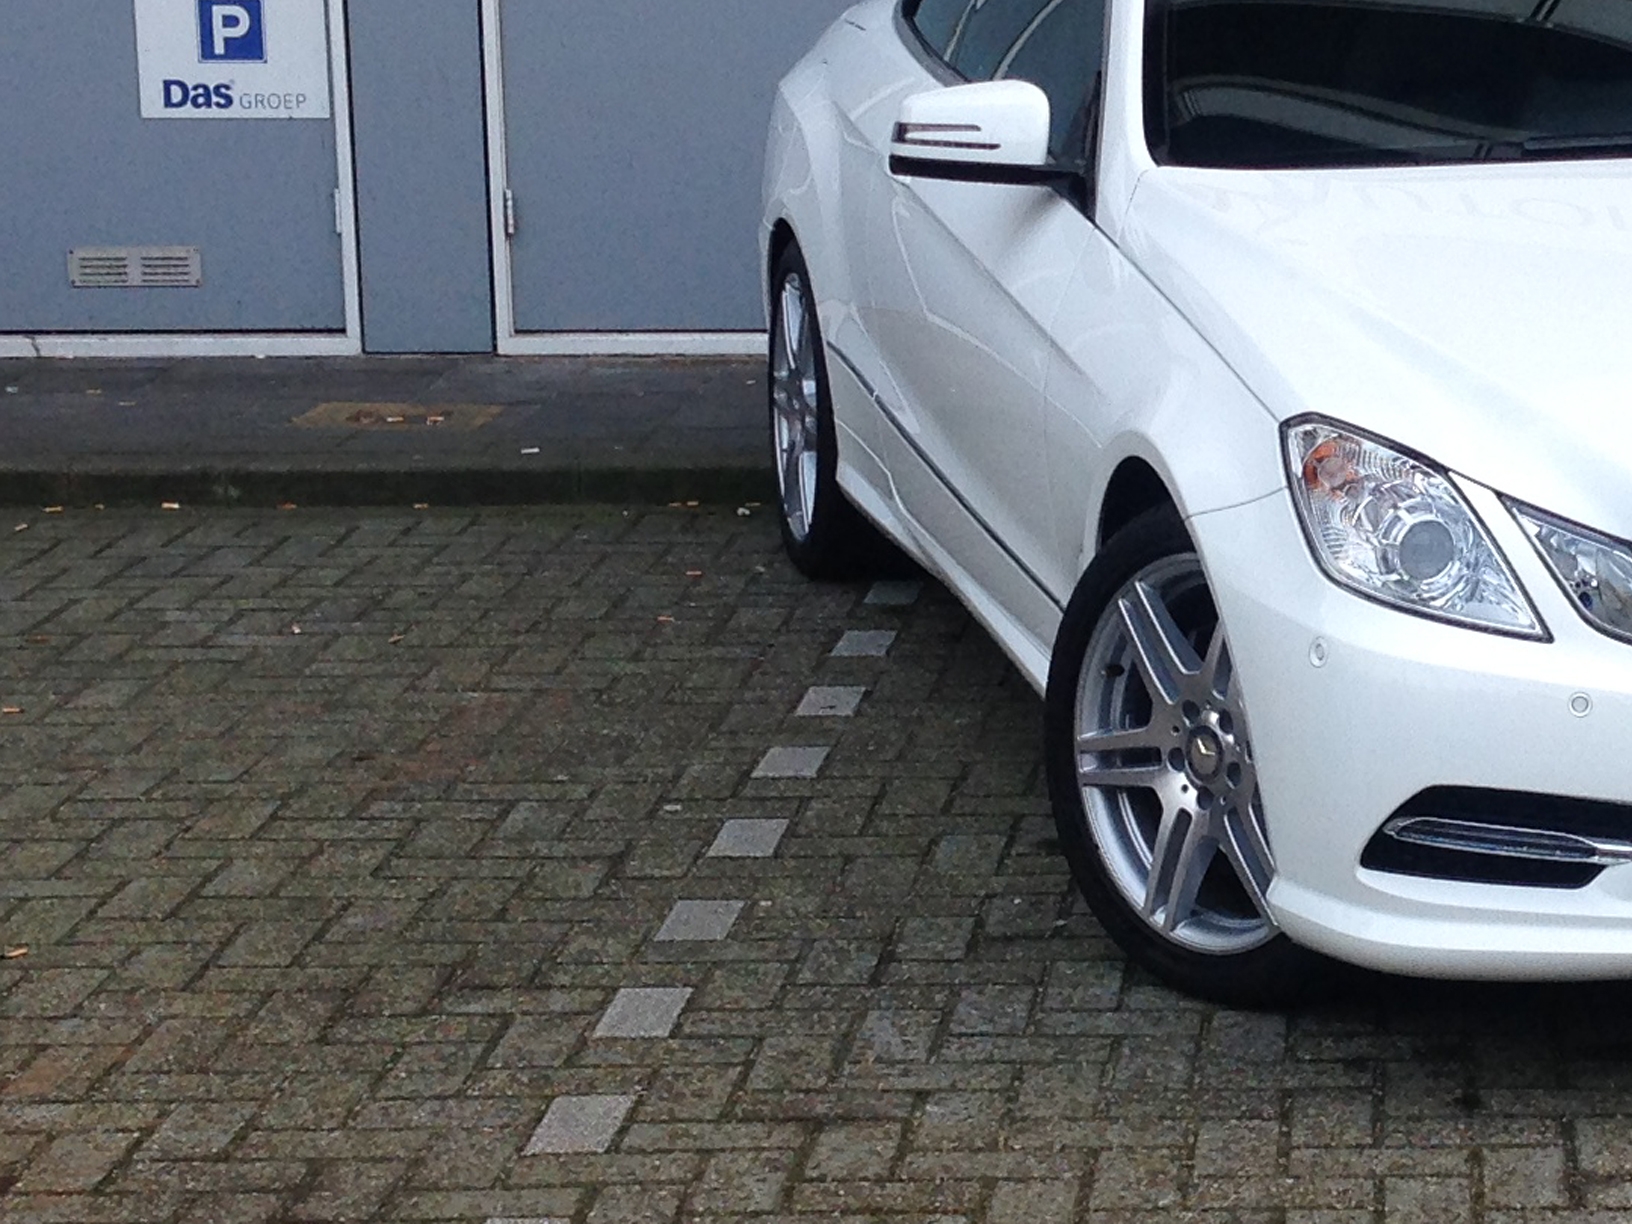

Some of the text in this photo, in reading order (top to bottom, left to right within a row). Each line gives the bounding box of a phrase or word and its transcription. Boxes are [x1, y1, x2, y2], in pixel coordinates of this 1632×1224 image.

[211, 4, 251, 56] P
[162, 79, 307, 110] Das GROEP
